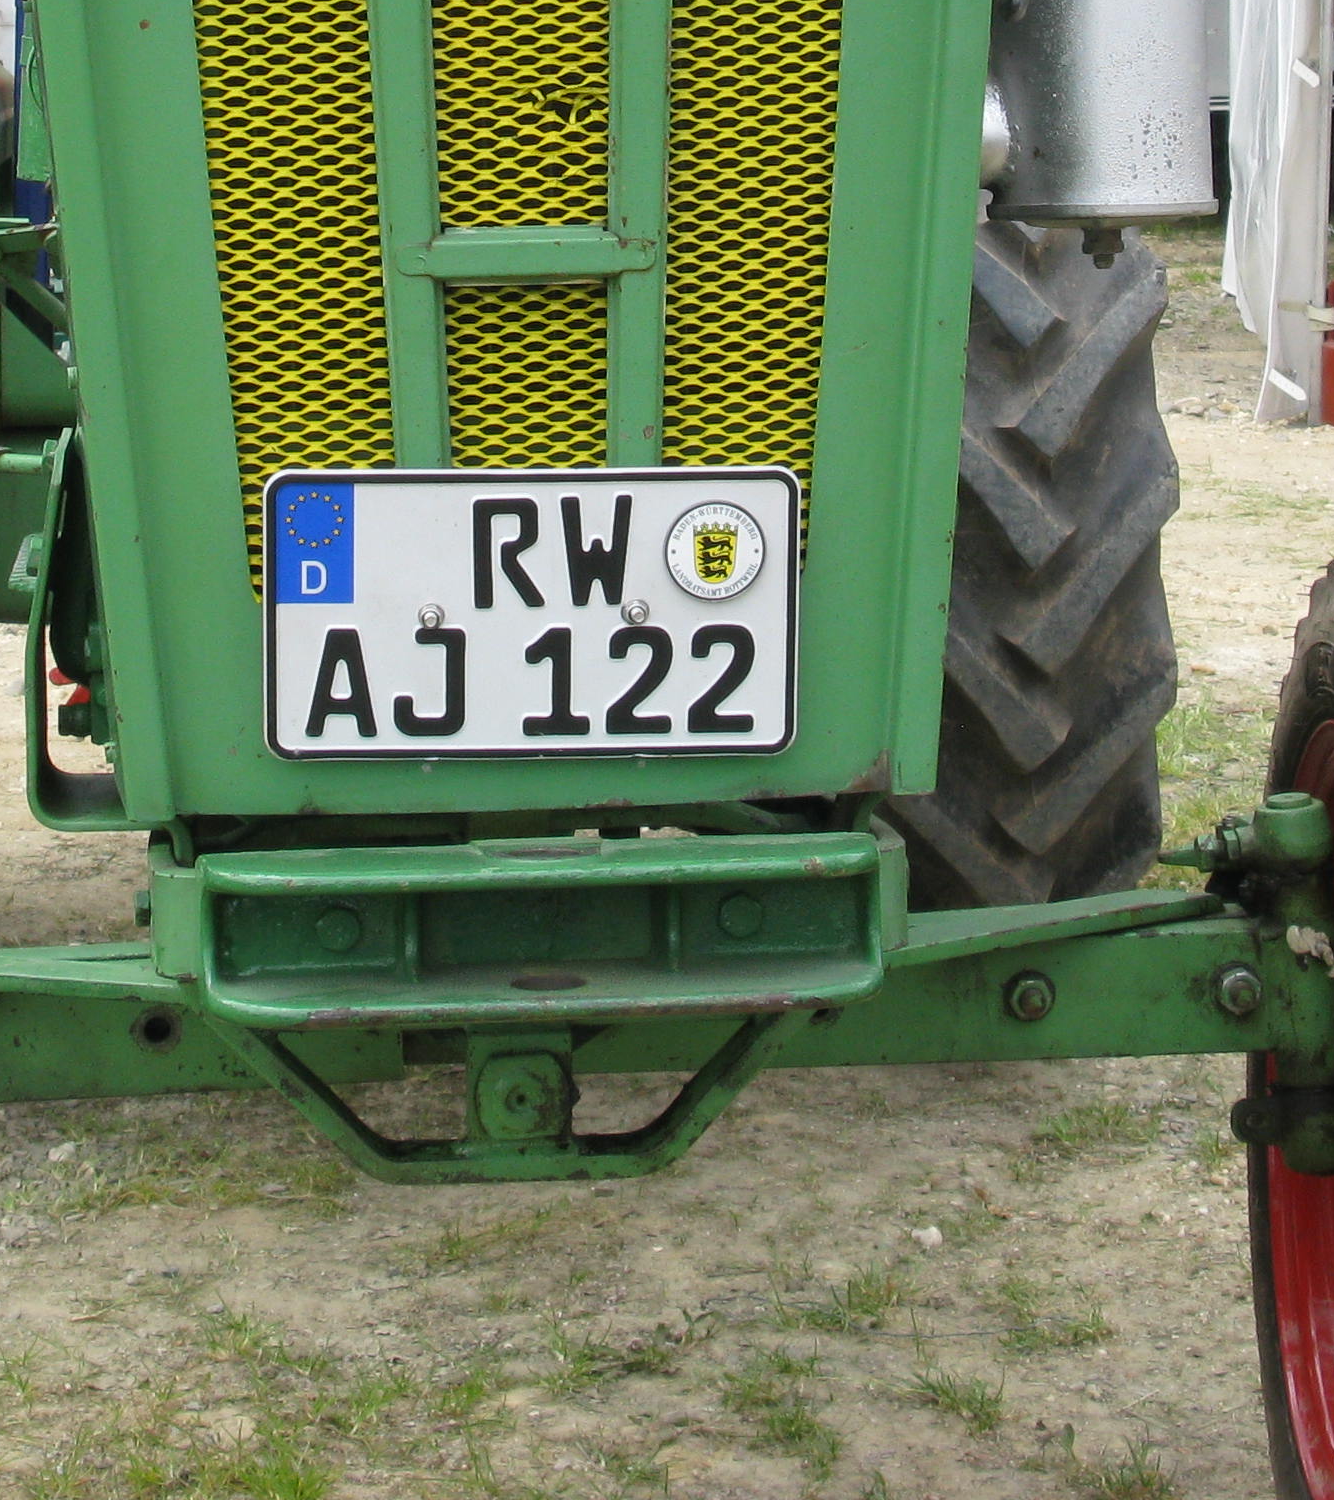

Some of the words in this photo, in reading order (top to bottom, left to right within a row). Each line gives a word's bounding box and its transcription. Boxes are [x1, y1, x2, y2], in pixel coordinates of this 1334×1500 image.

[300, 560, 329, 595] D
[472, 494, 633, 609] RW
[724, 563, 759, 596] ROTTWEIL
[305, 627, 467, 737] AJ
[522, 623, 756, 737] 122
